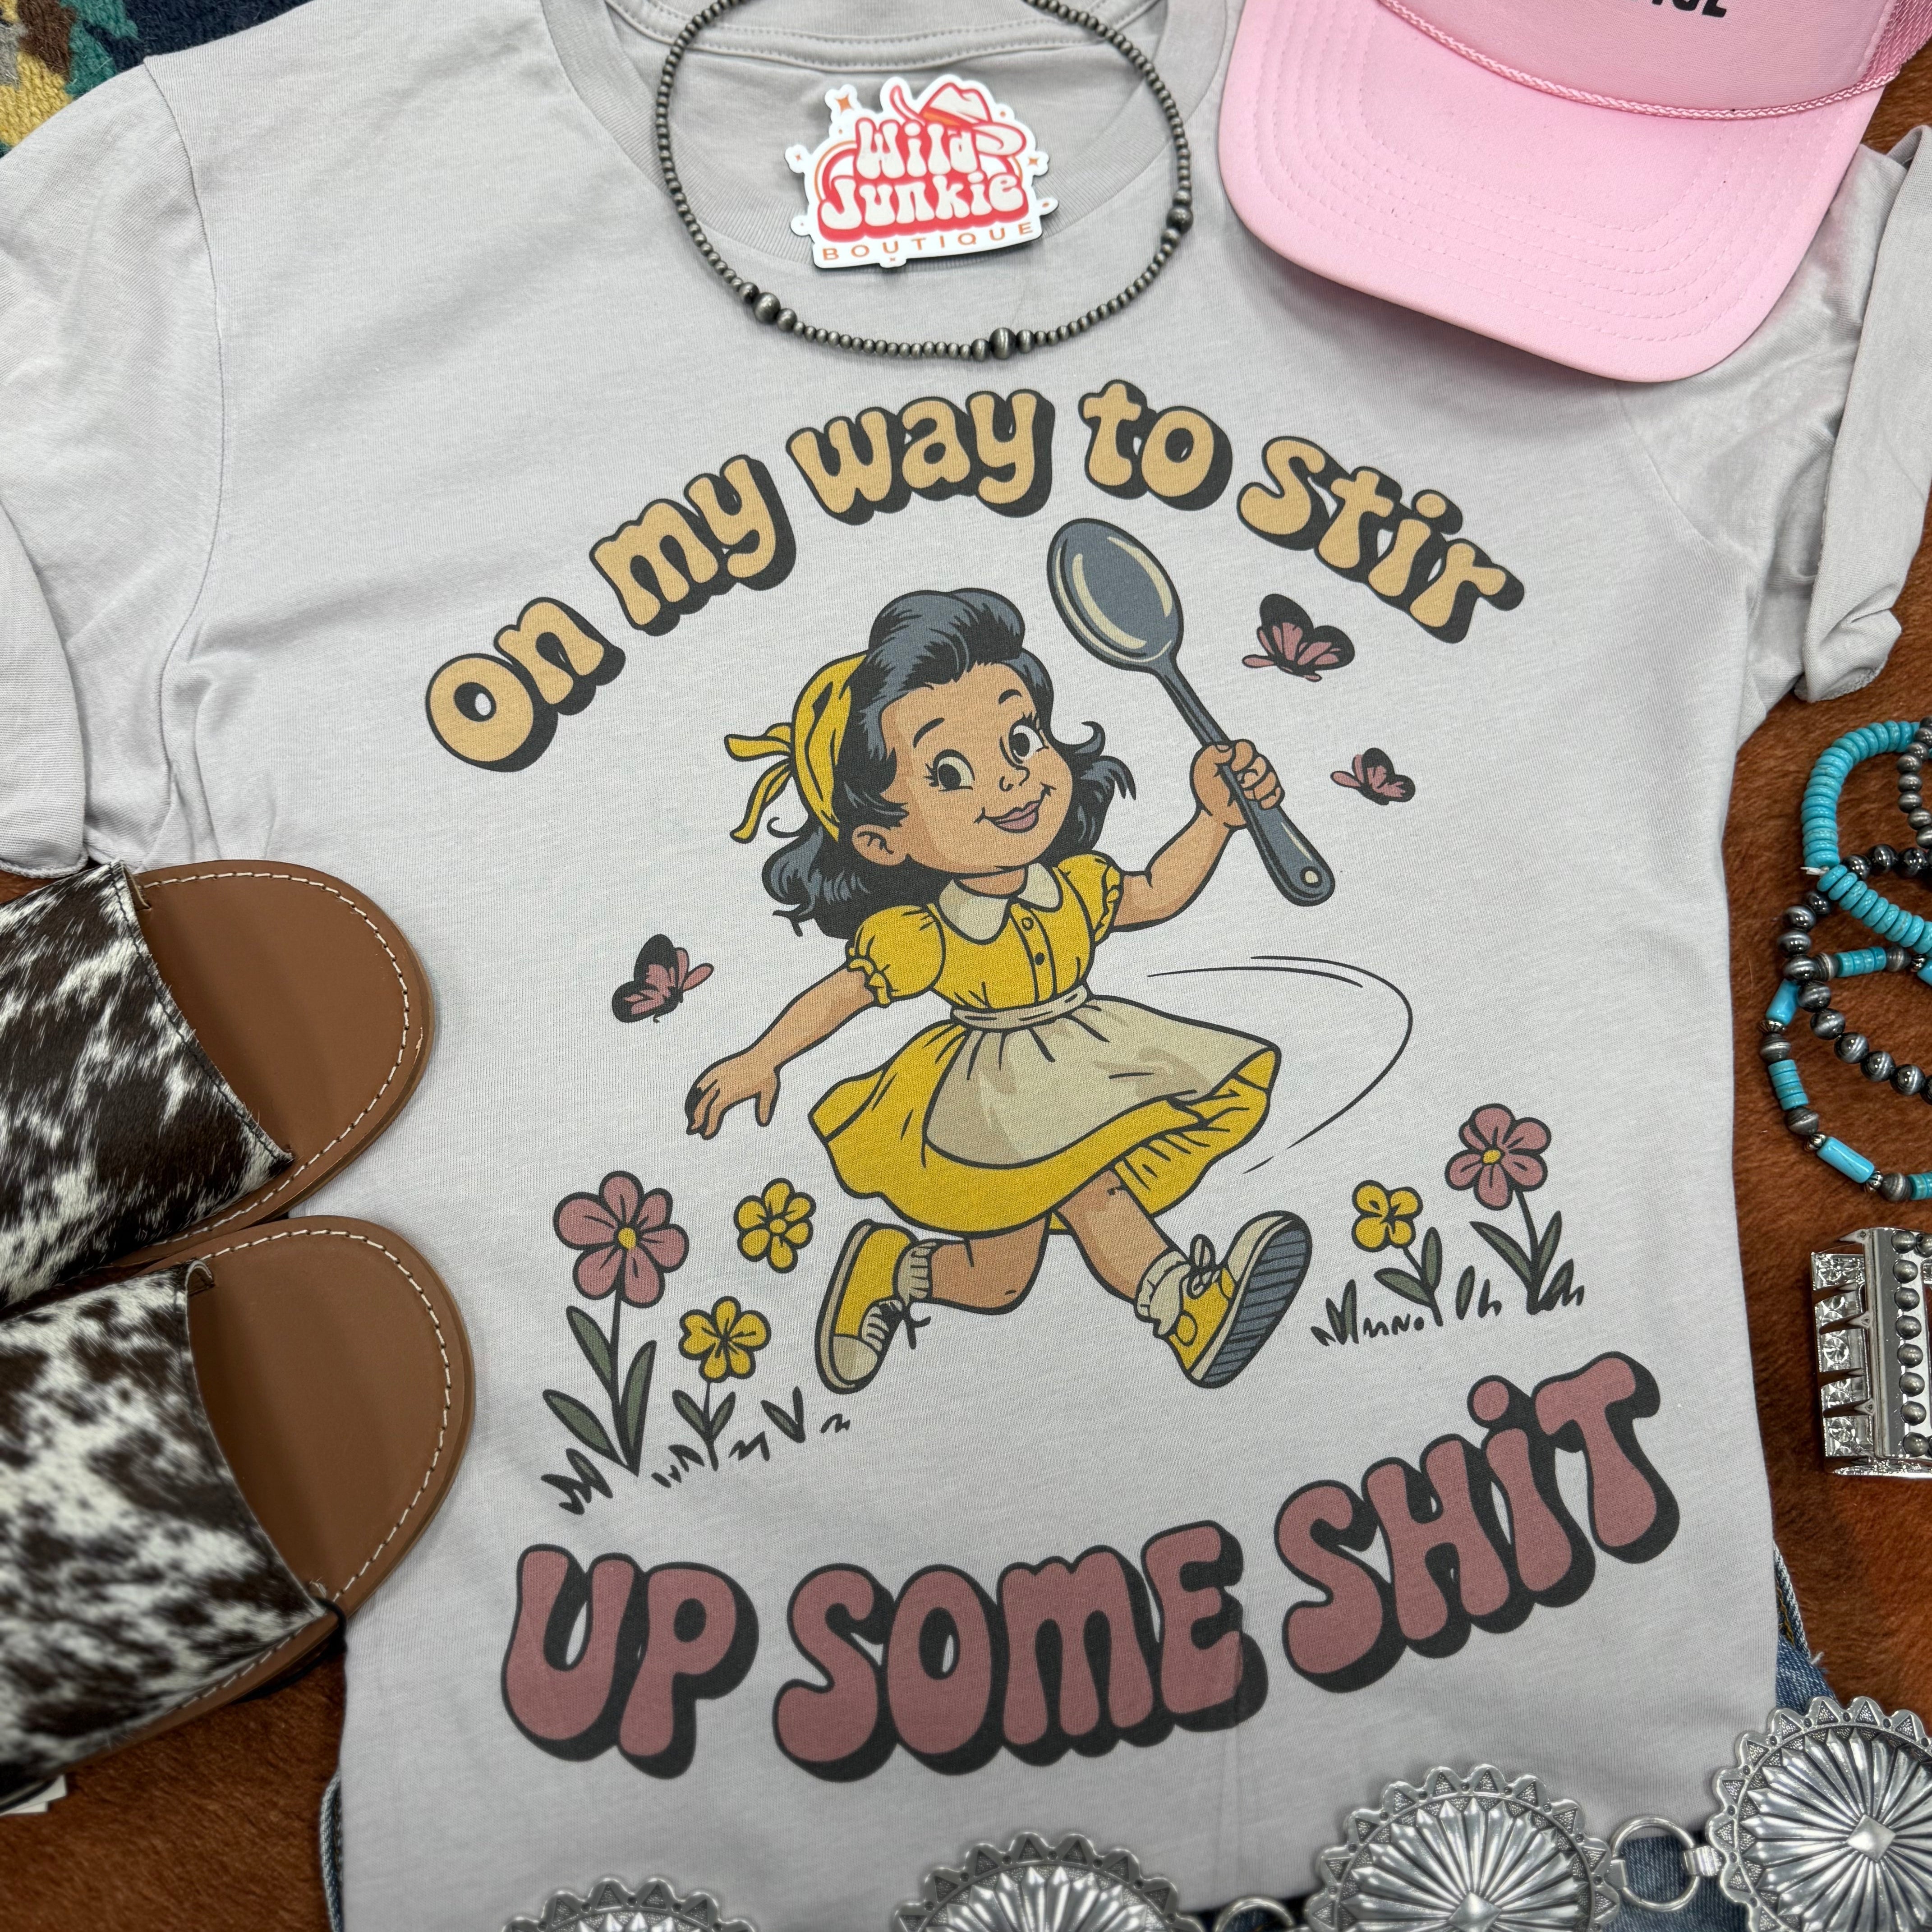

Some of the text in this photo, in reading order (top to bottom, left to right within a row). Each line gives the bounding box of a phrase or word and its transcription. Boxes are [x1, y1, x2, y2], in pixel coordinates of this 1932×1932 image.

[856, 117, 979, 179] Wild
[819, 171, 1030, 243] Junkie
[822, 222, 1034, 261] BOUTIQUE
[589, 454, 796, 636] my
[785, 388, 1055, 525] way
[1077, 379, 1233, 511] to
[500, 1543, 759, 1780] UP
